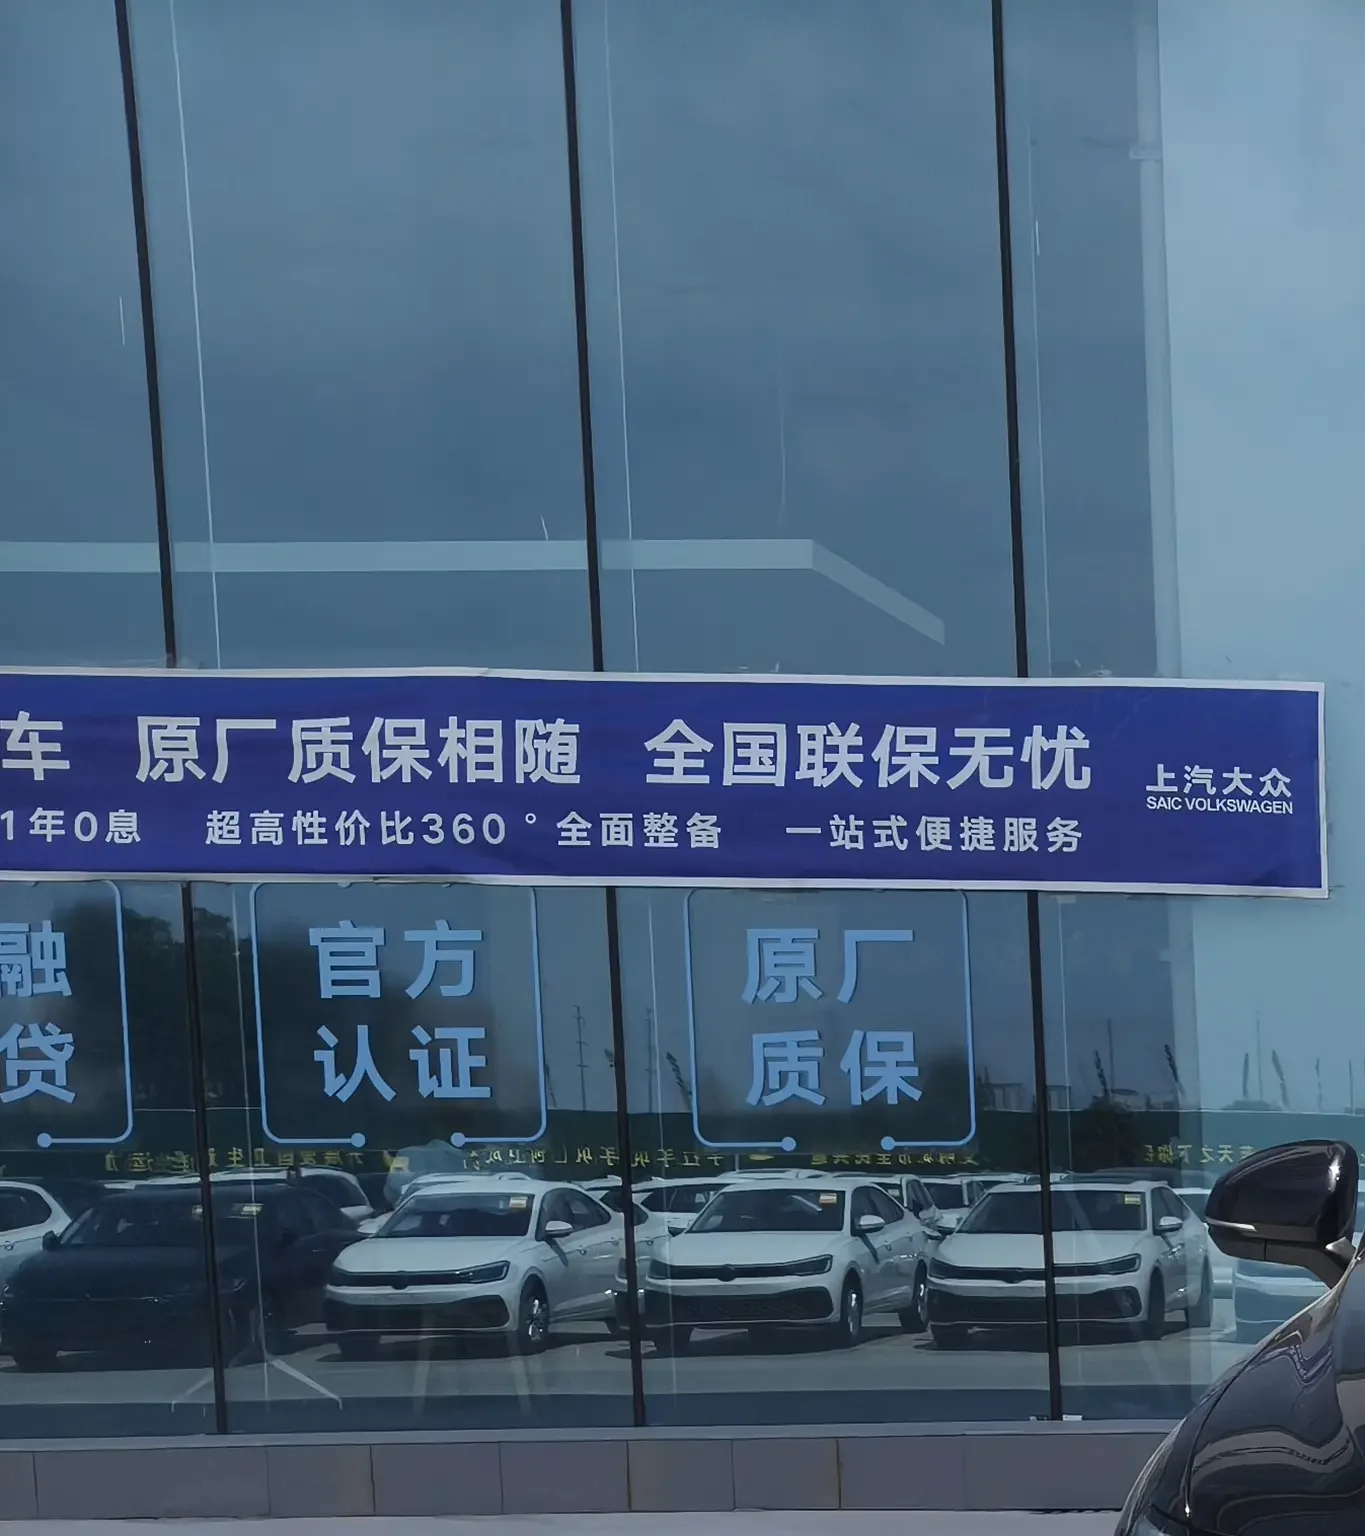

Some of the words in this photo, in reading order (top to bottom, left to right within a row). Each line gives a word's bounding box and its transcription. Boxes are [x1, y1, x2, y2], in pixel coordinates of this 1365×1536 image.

[0, 711, 71, 781] 车
[136, 715, 580, 784] 原厂质保相随
[644, 718, 1092, 791] 全国联保无忧
[1146, 763, 1292, 798] 上汽大众
[786, 813, 1083, 853] 一站式便捷服务
[1146, 796, 1182, 811] SAIC
[1185, 797, 1293, 815] VOLKSWAGEN
[308, 919, 484, 1000] 官方
[742, 927, 914, 1004] 原厂
[0, 1022, 76, 1103] 贷
[314, 1024, 491, 1102] 认证
[745, 1029, 924, 1107] 质保
